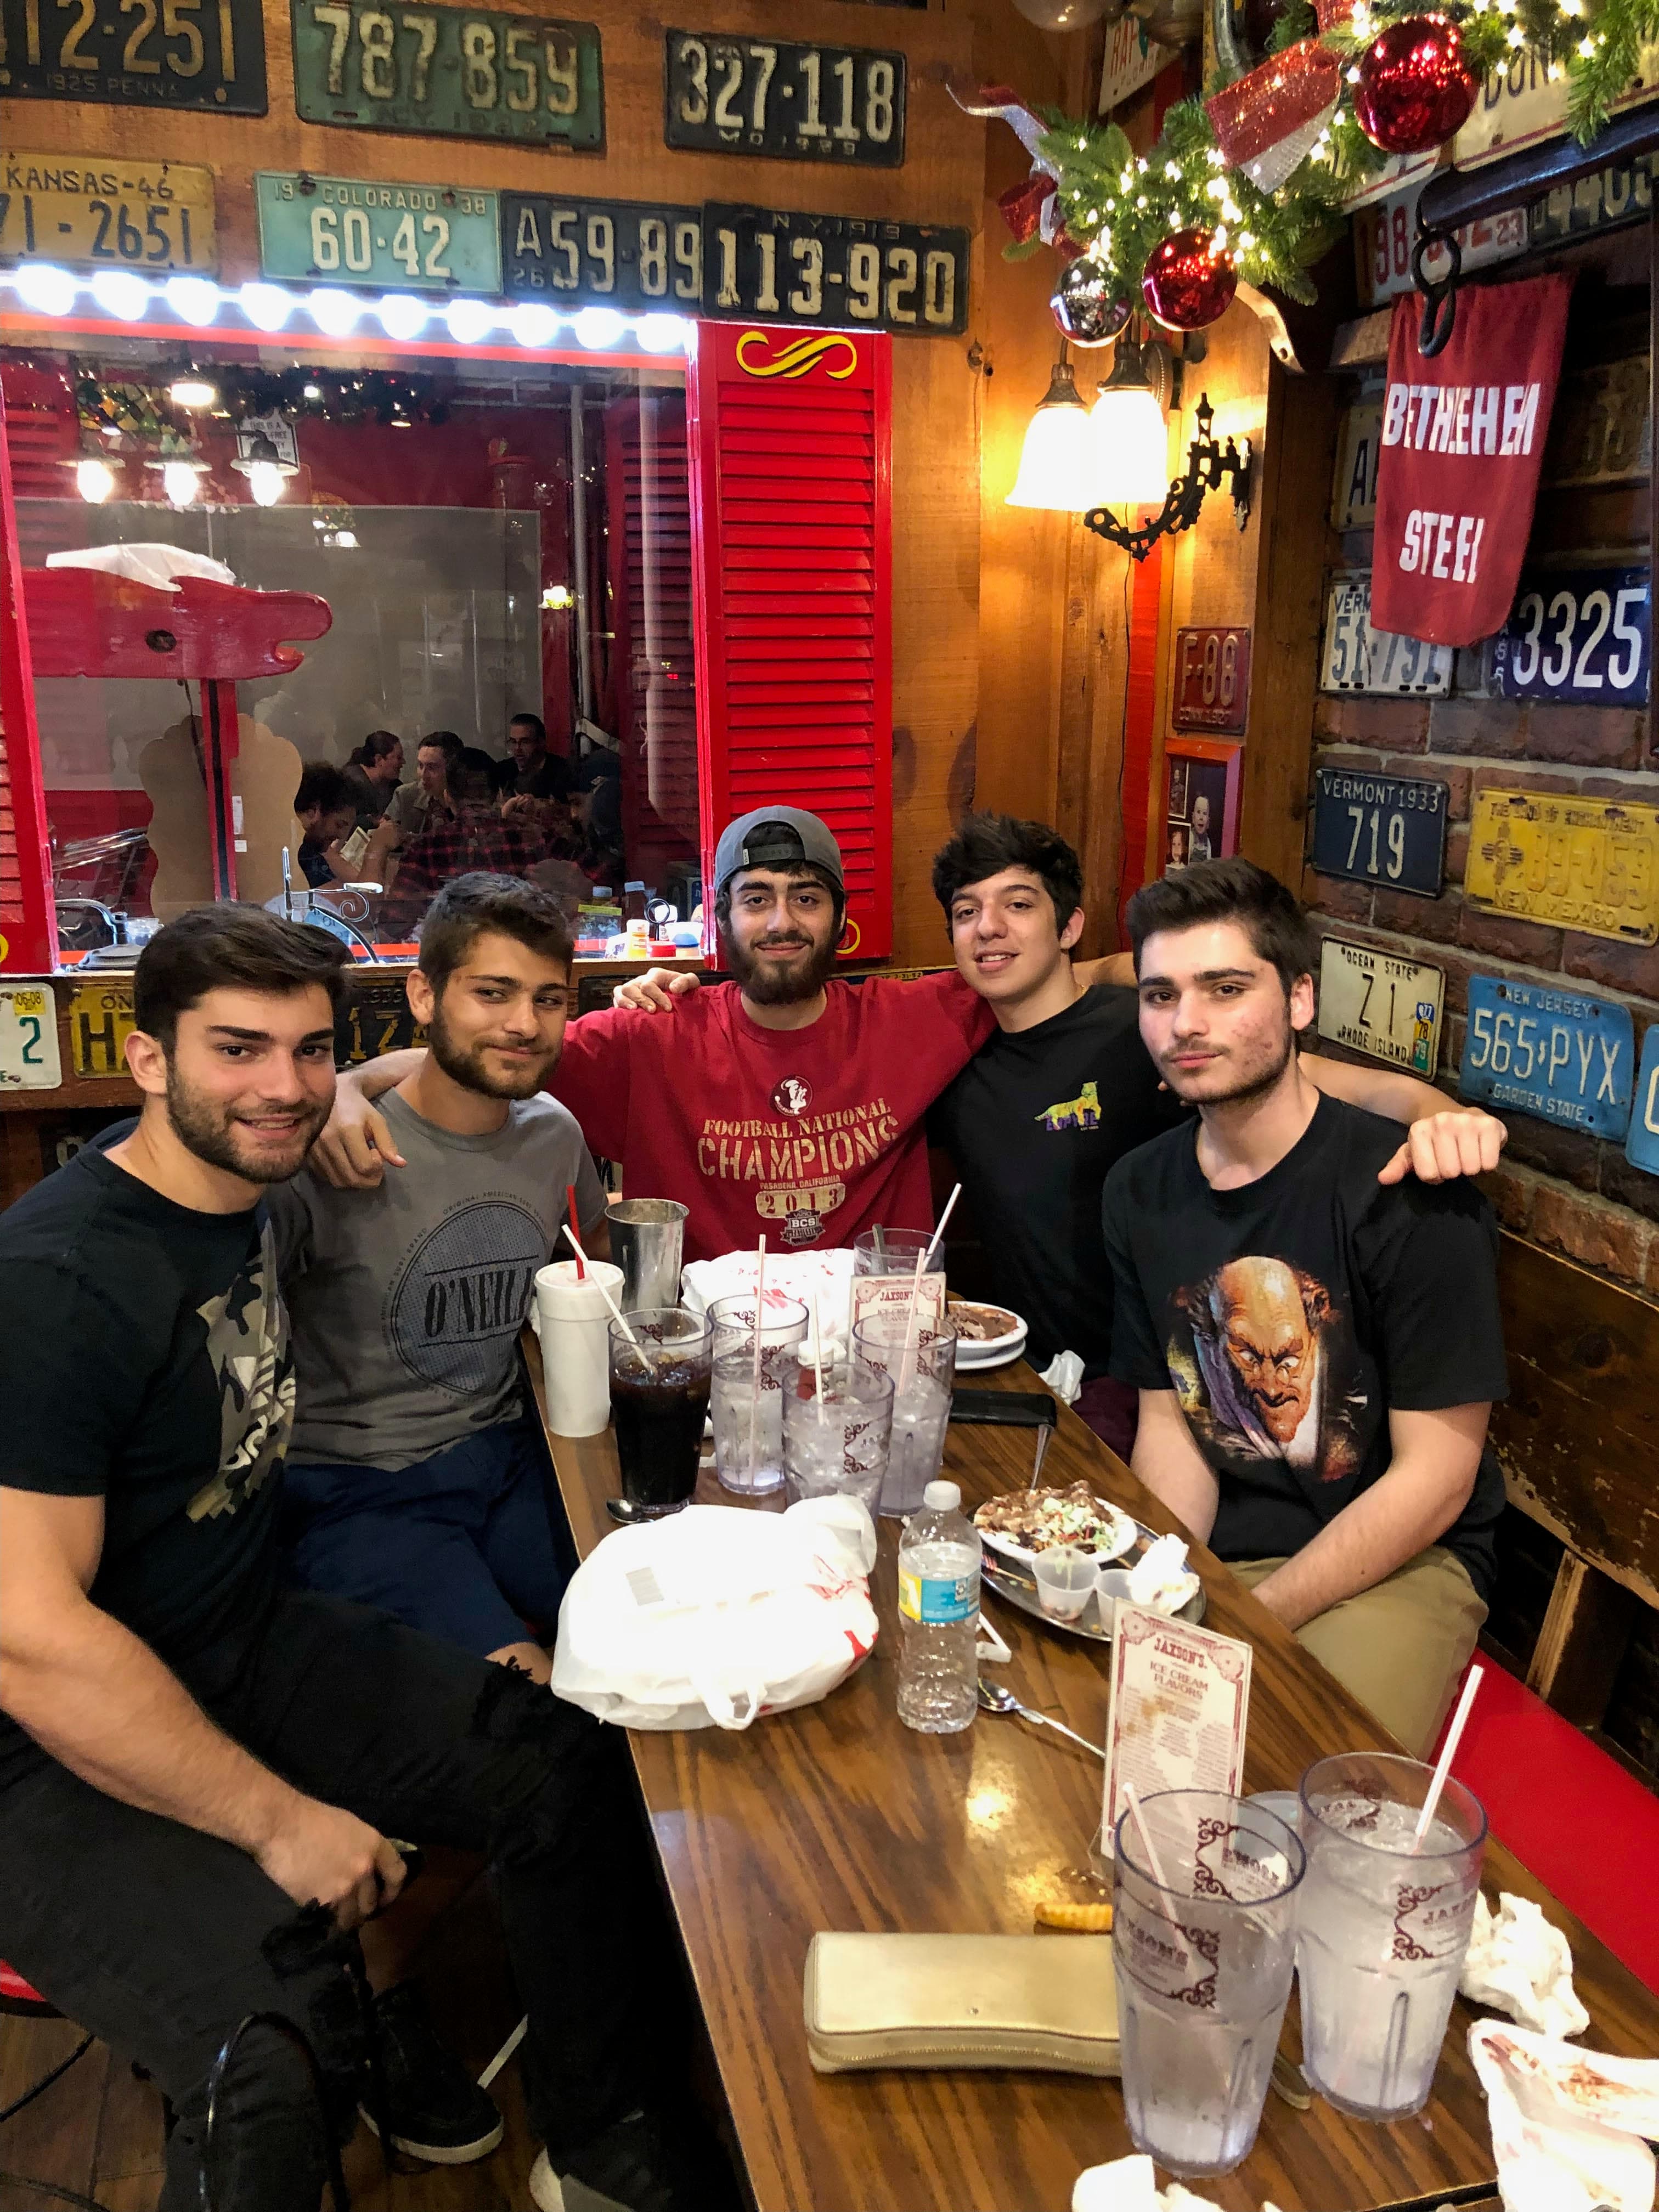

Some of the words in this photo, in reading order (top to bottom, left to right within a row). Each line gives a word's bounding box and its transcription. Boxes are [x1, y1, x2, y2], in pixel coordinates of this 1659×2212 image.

[275, 181, 294, 200] 19
[322, 185, 437, 211] COLORADO
[461, 196, 486, 215] 38
[717, 228, 928, 326] 113-920
[1512, 588, 1647, 689] 3325
[1323, 777, 1395, 805] VERMONT
[1398, 788, 1438, 813] 1933
[1346, 805, 1404, 879] 719
[1494, 889, 1537, 913] NEW
[1543, 898, 1617, 928] MEXICO
[1346, 950, 1375, 969] OCEAN
[1385, 961, 1413, 981] STATE
[16, 991, 42, 1006] 06-08
[1505, 988, 1531, 1006] NEW
[1536, 991, 1593, 1019] JERSEY
[1341, 1024, 1369, 1049] RHODE
[1374, 1036, 1409, 1062] ISLAND
[1419, 1022, 1429, 1039] 78
[1415, 1040, 1427, 1060] 79
[702, 1119, 793, 1138] FOOTBALL
[797, 1097, 891, 1136] NATIONAL
[1493, 1083, 1543, 1111] GARDEN
[1546, 1097, 1585, 1122] STATE
[765, 1188, 838, 1214] 2013
[791, 1218, 816, 1228] BCS
[1150, 1661, 1165, 1673] ICE
[1170, 1669, 1209, 1691] CREAM
[1154, 1673, 1203, 1700] FLAVORS
